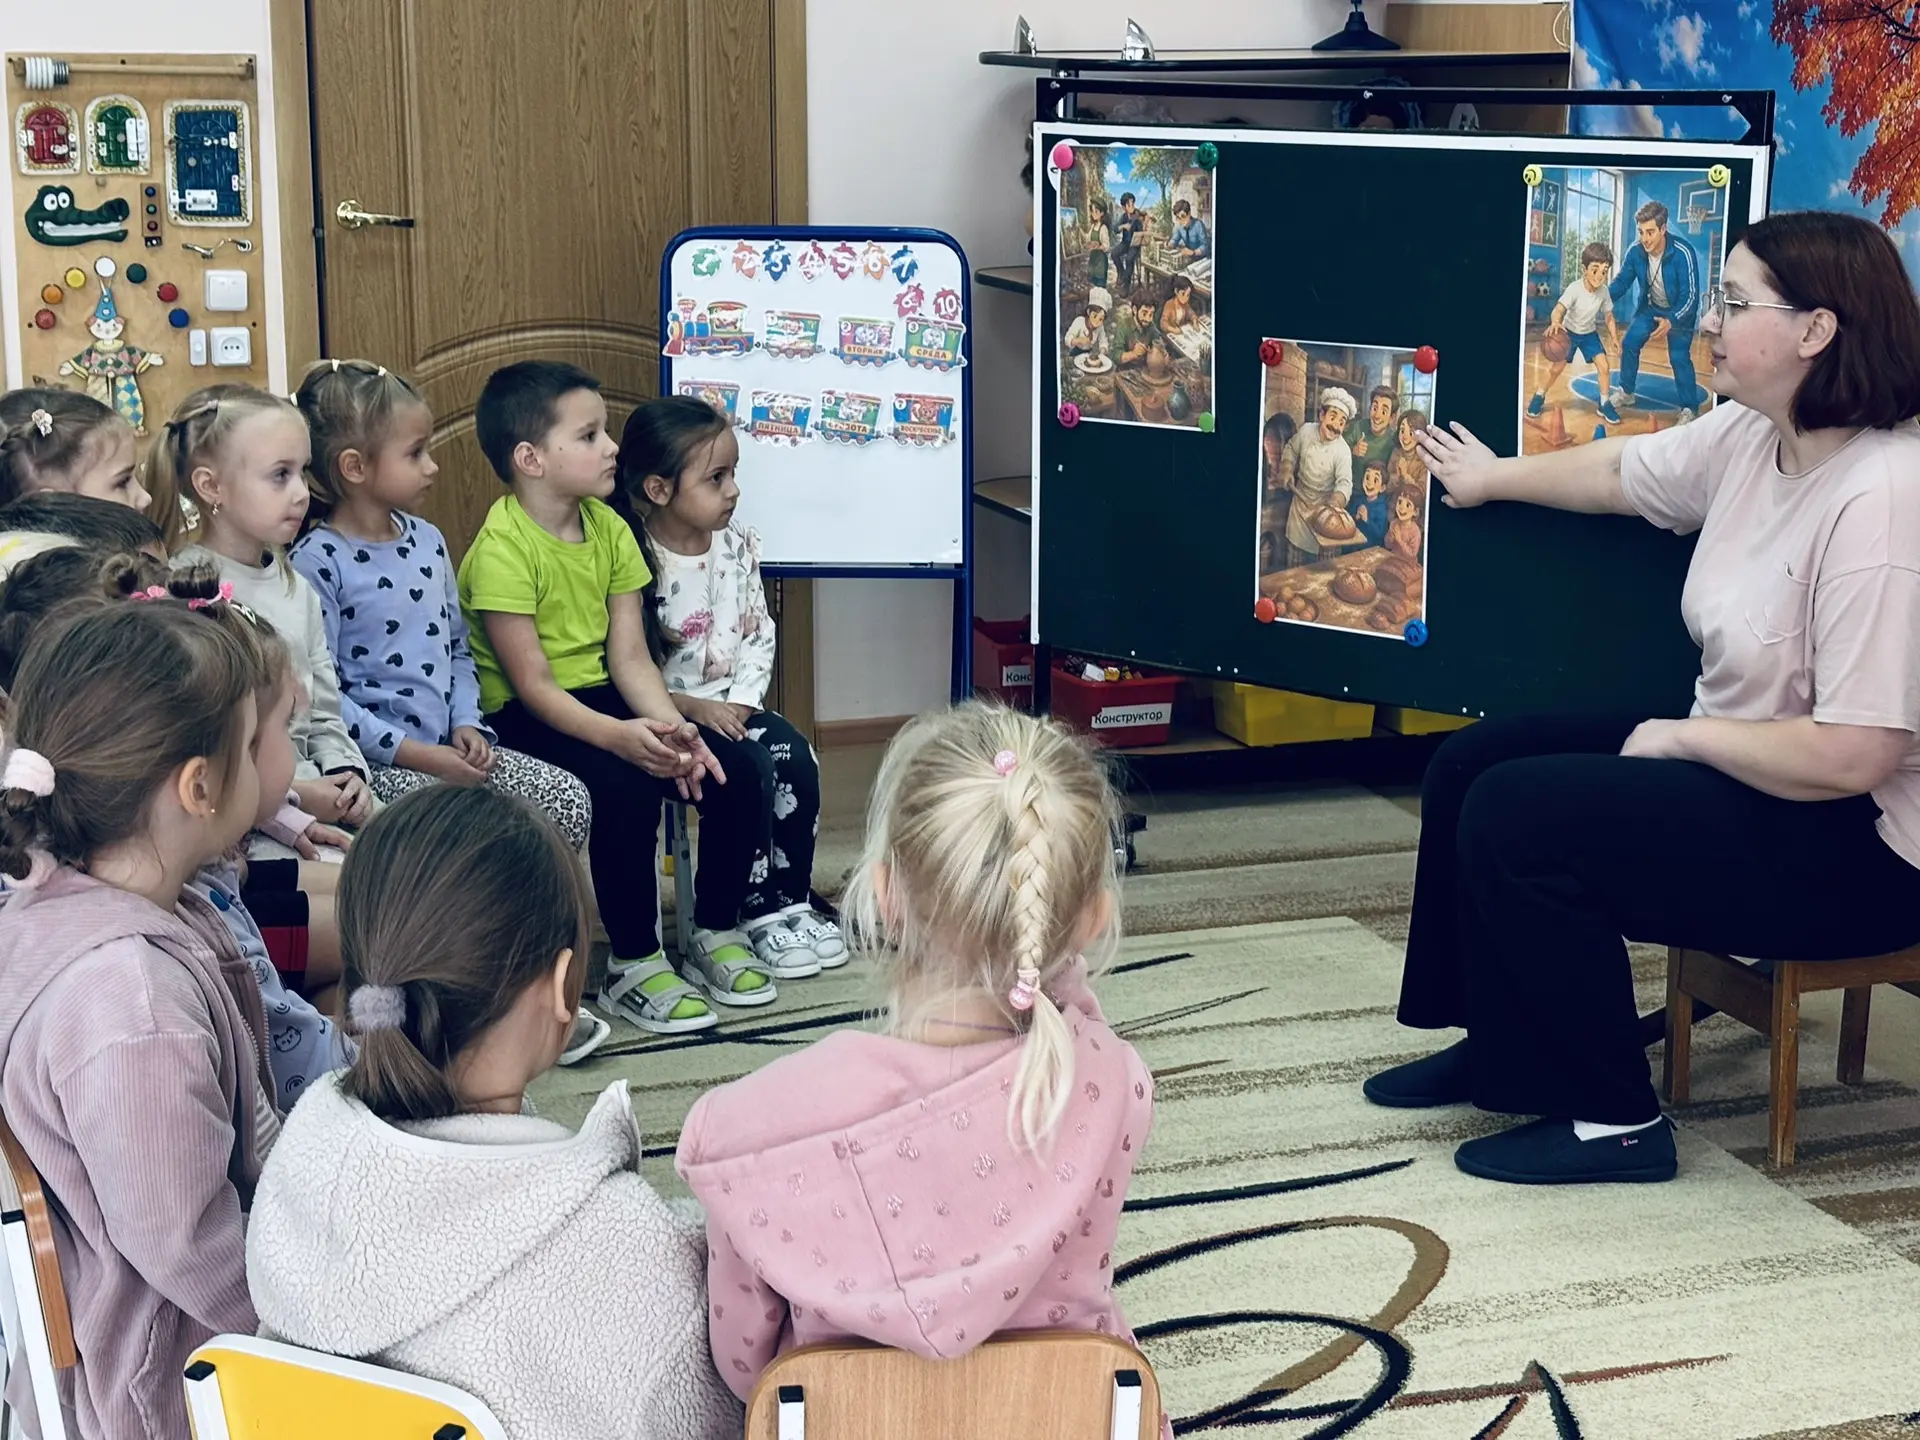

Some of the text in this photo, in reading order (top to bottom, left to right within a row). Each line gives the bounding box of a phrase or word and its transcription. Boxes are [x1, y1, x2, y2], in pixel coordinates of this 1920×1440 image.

[937, 295, 957, 315] 10
[847, 346, 884, 355] ВТОРНИК
[916, 350, 947, 359] СРЕДА
[758, 422, 799, 434] ПЯТНИЦА
[1094, 711, 1163, 725] Конструктор
